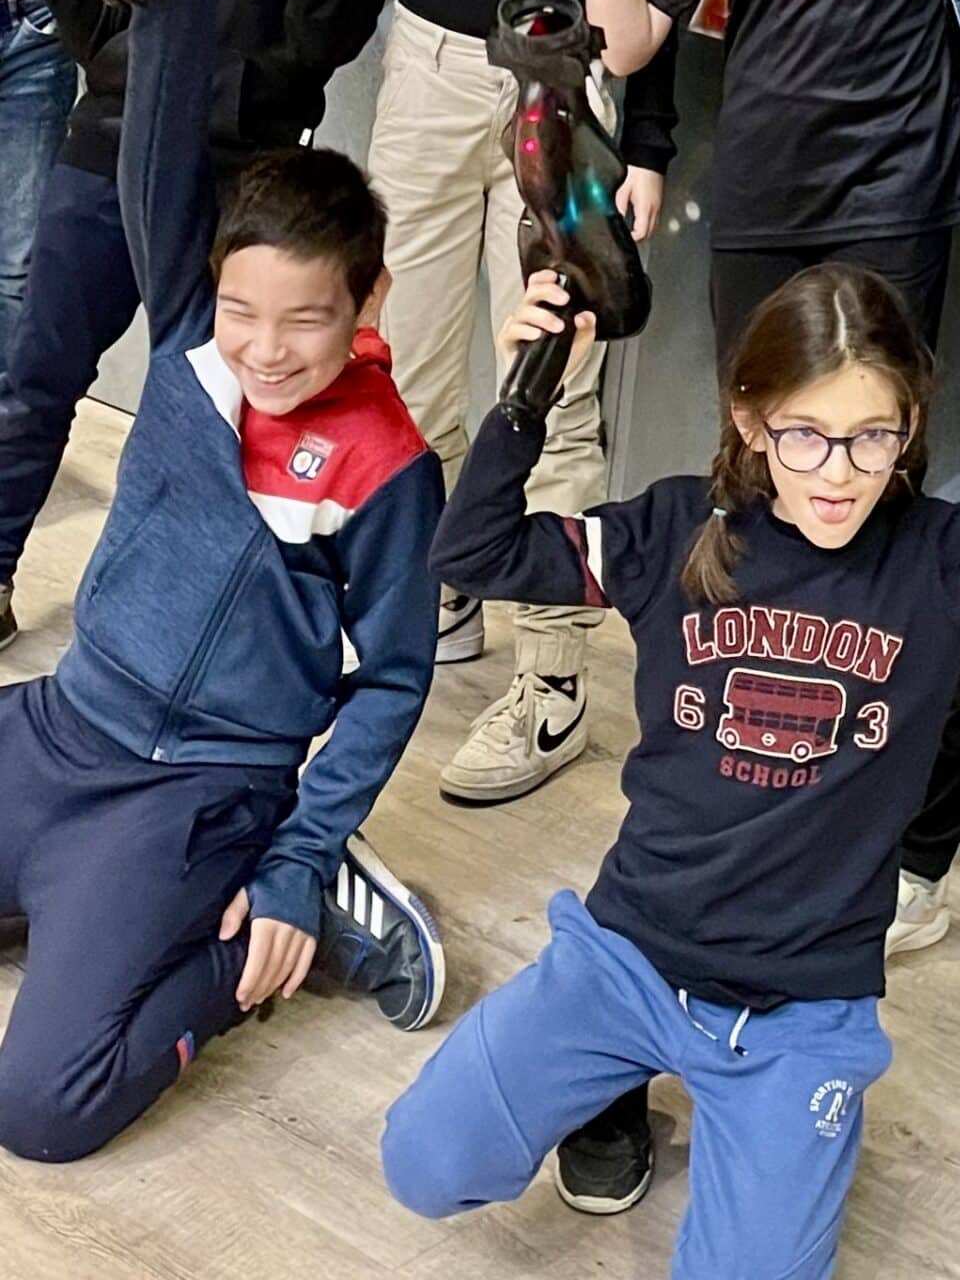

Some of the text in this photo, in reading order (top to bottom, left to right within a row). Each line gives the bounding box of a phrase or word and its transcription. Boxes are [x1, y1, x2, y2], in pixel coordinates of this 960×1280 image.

[683, 606, 903, 683] LONDON
[674, 685, 889, 750] 6 3
[718, 755, 823, 789] SCHOOL
